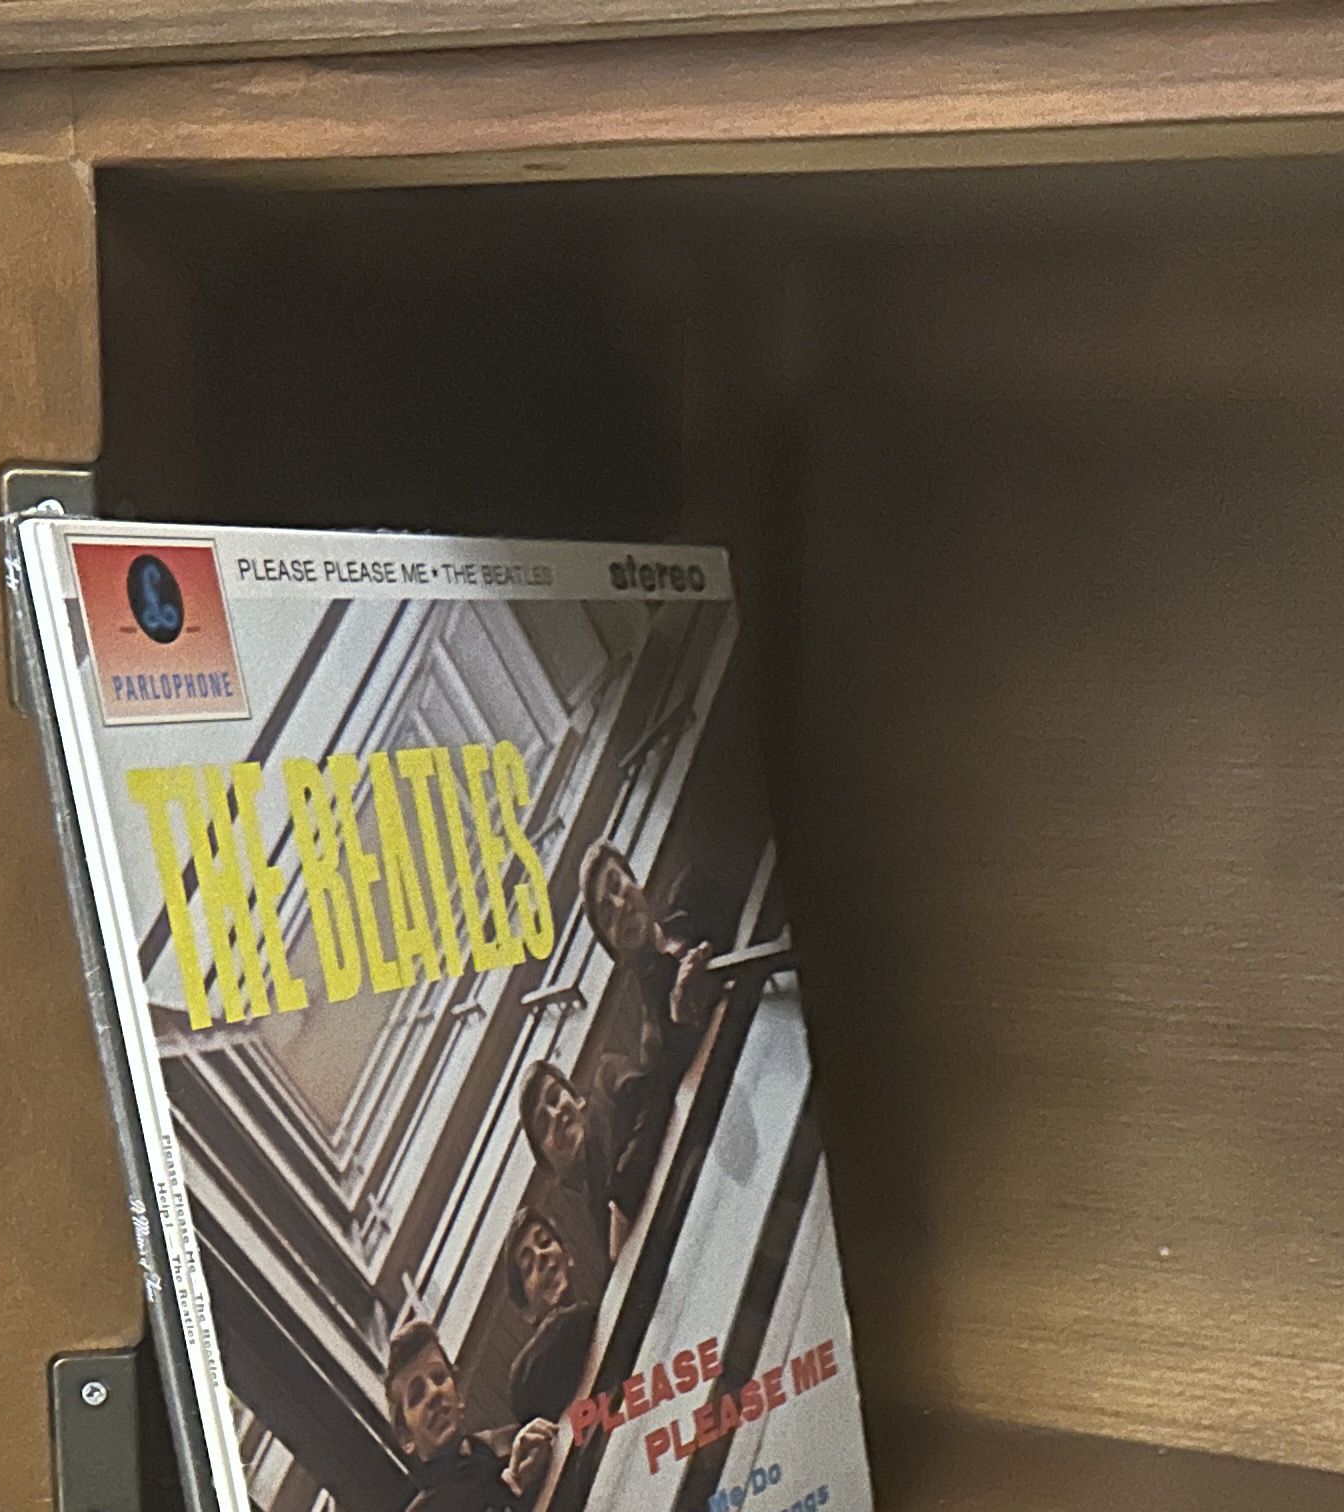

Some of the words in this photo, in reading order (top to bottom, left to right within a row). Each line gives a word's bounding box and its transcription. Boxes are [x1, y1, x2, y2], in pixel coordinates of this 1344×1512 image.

[237, 558, 318, 583] PLEASE
[323, 559, 396, 585] PLEASE
[400, 562, 430, 585] ME
[441, 563, 477, 585] THE
[480, 563, 554, 587] BEATLES
[608, 553, 705, 593] stereo
[112, 671, 234, 701] PARLOPHONE
[126, 761, 309, 1031] THE
[282, 740, 555, 1004] BEATLES
[567, 1336, 724, 1447] PLEASE
[644, 1365, 787, 1475] PLEASE
[790, 1338, 839, 1396] ME
[749, 1462, 783, 1497] Do
